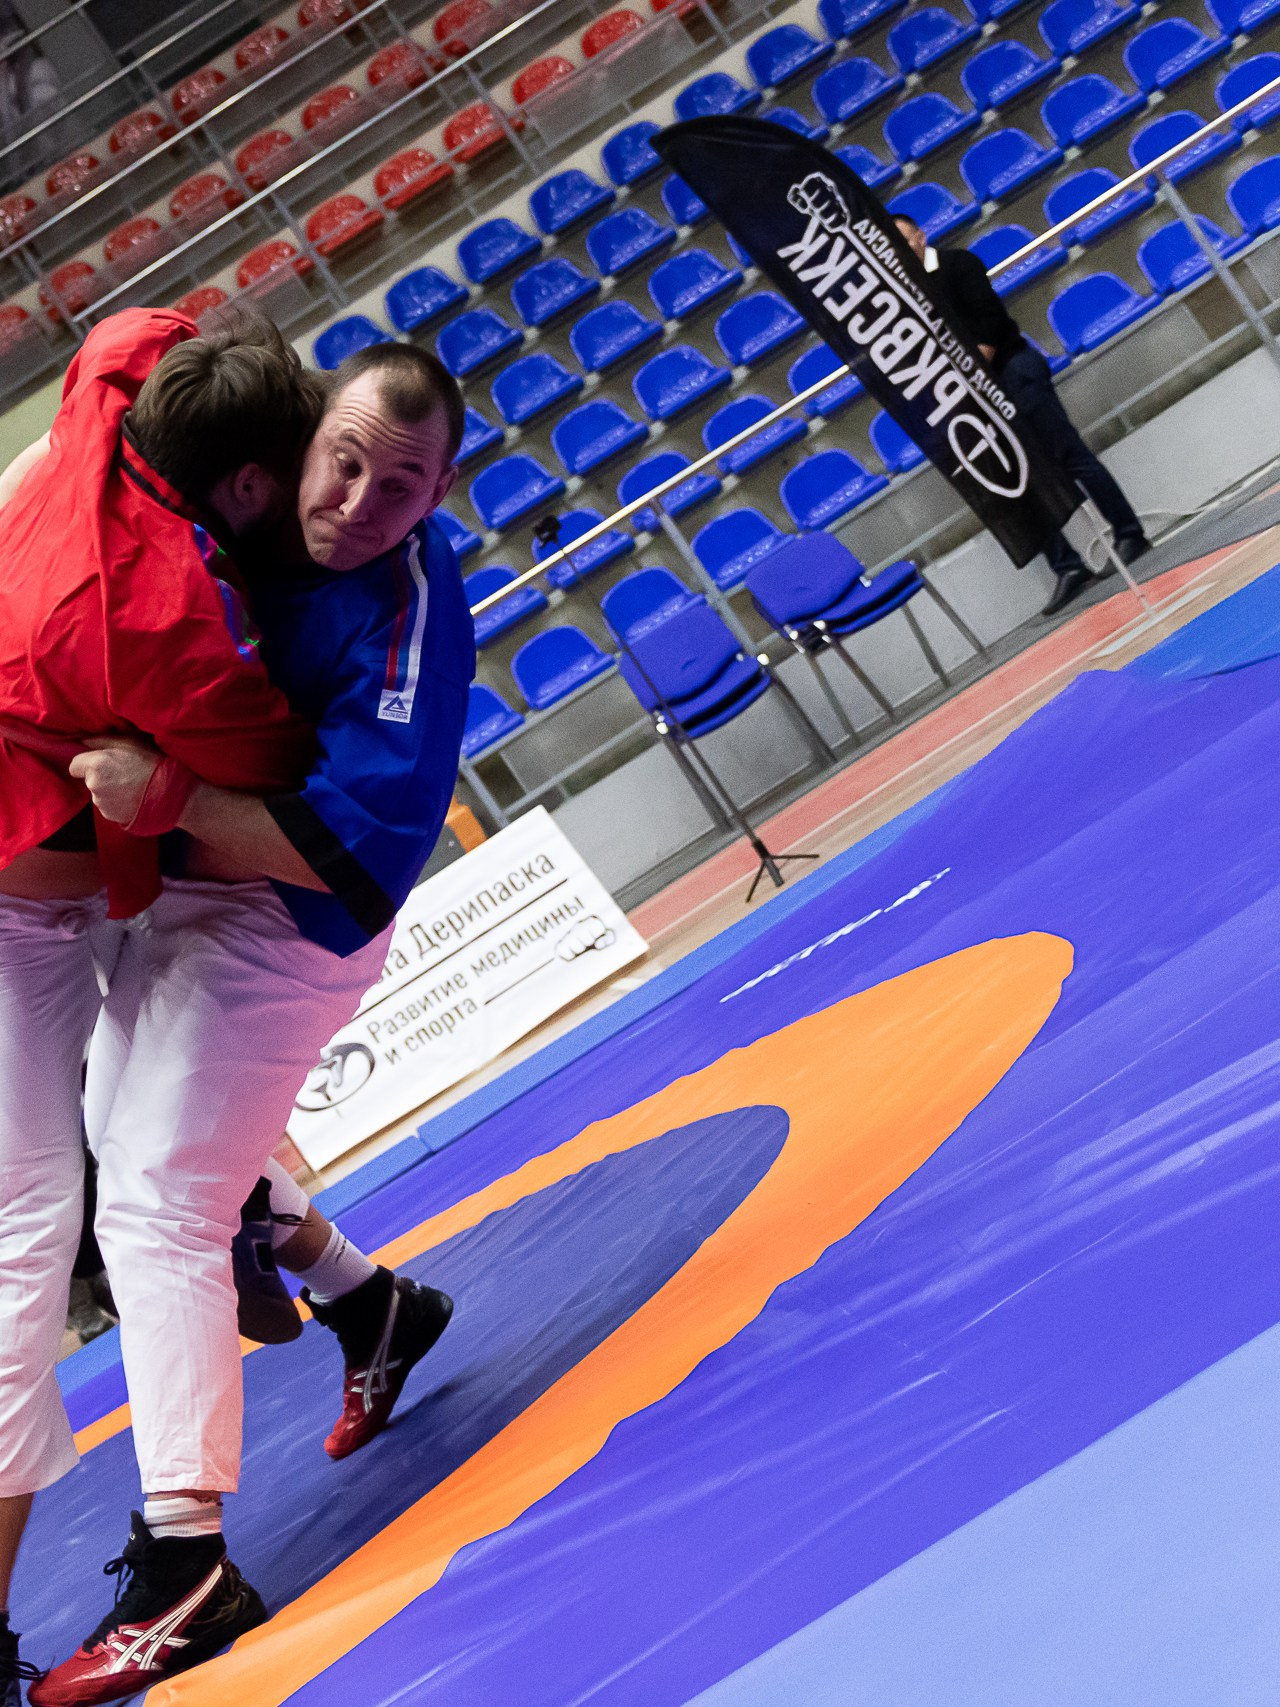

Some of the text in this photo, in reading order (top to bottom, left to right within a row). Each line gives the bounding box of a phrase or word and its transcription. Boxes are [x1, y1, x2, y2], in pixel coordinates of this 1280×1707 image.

[408, 853, 556, 960] Дерипаска
[366, 970, 468, 1044] Развитие
[471, 894, 586, 980] медицины
[384, 996, 479, 1067] и спорта
